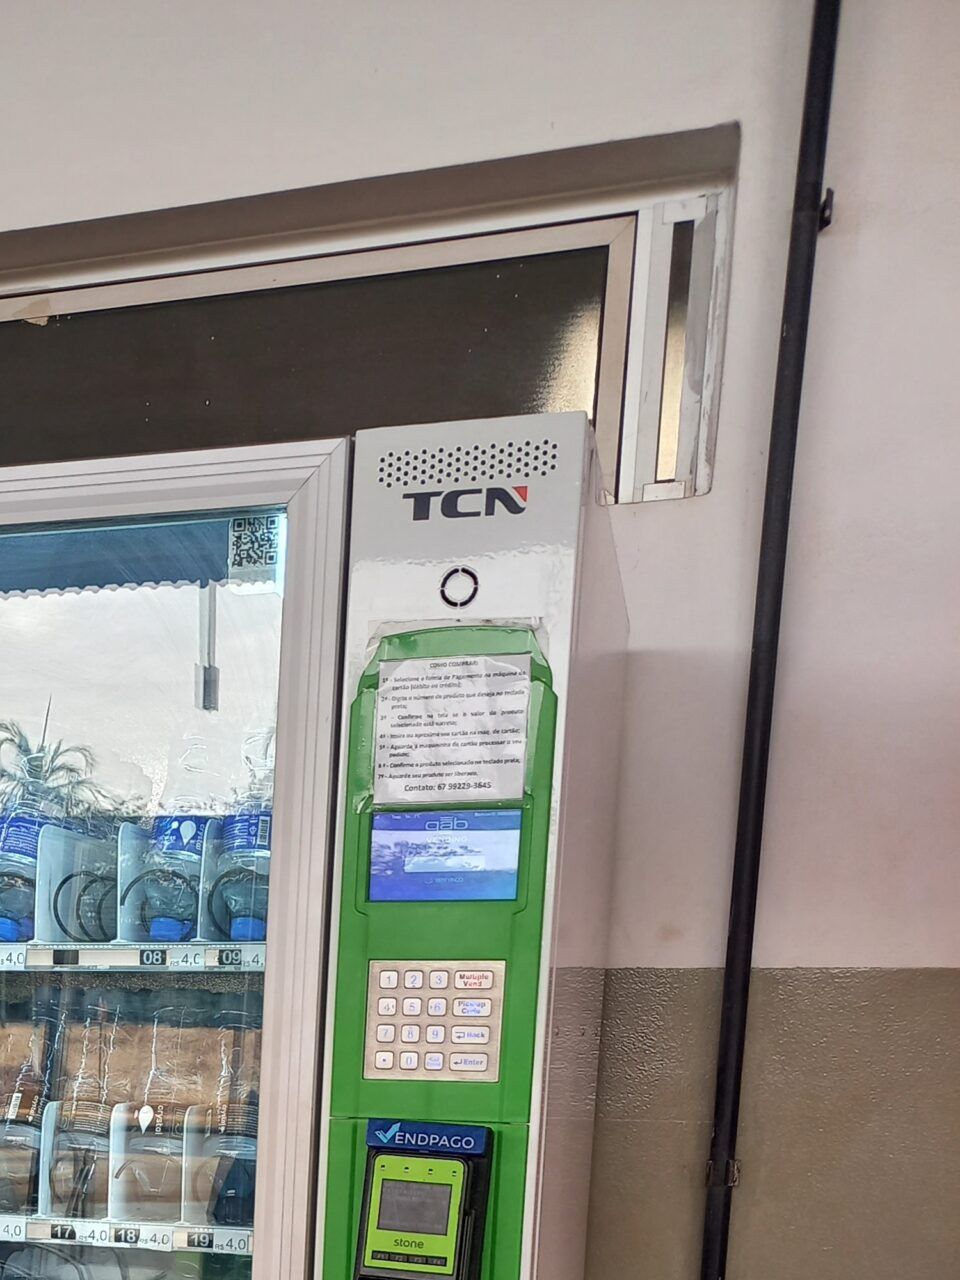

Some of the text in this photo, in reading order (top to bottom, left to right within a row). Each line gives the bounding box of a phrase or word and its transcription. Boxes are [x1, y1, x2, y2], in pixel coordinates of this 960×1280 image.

[402, 486, 528, 521] TCN
[404, 784, 436, 792] Contato:
[437, 783, 446, 791] 67
[143, 950, 162, 965] 08
[222, 950, 241, 964] 09
[386, 974, 442, 985] 1 2 3
[409, 1002, 416, 1012] 5
[433, 1002, 441, 1012] 6
[431, 1029, 439, 1039] 9
[463, 1058, 484, 1066] Enter
[54, 1225, 72, 1238] 17
[117, 1229, 136, 1242] 18
[190, 1233, 209, 1247] 19
[393, 1237, 425, 1249] stone
